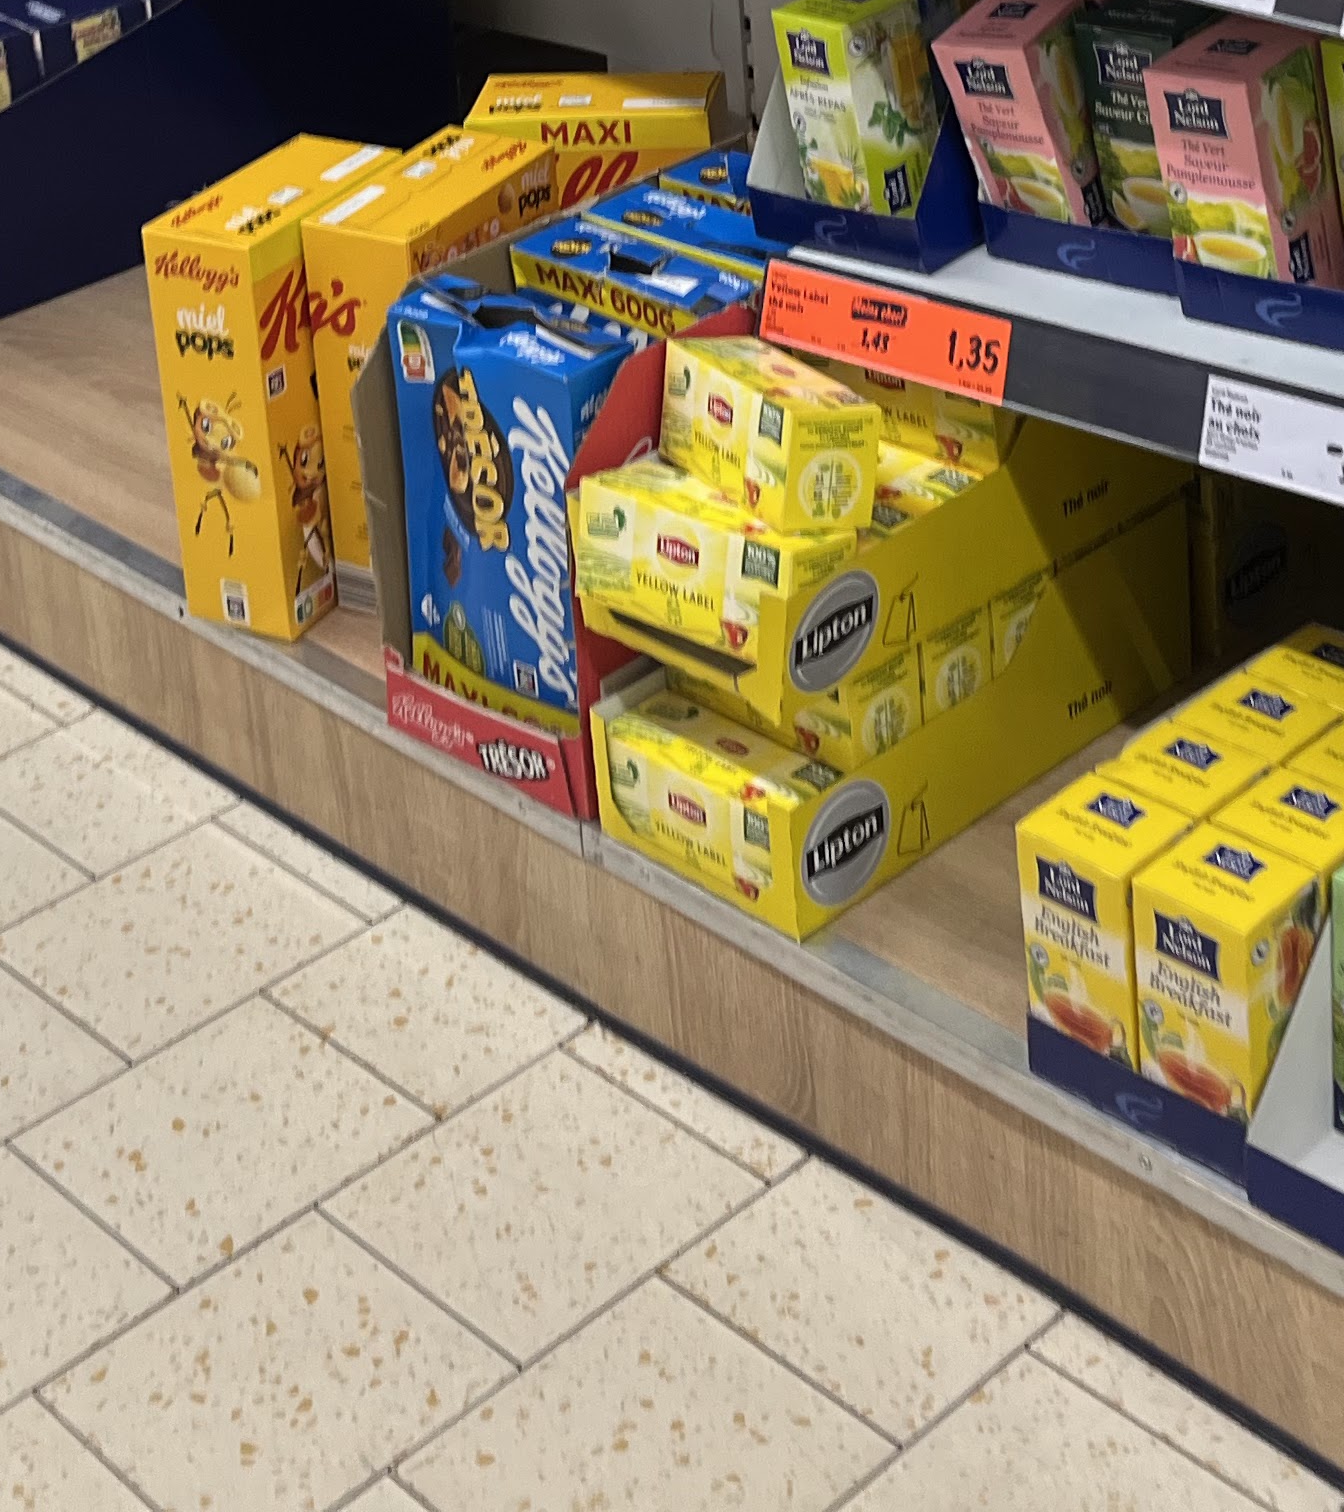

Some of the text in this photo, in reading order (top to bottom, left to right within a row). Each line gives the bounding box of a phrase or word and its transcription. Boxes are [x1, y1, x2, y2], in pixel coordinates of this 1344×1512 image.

[540, 119, 633, 147] MAXI
[1166, 163, 1255, 191] Pamplemousse
[154, 249, 240, 290] Kellogg's
[177, 304, 225, 333] miel
[535, 260, 677, 335] MAXI 600G
[175, 327, 235, 362] pops
[947, 330, 999, 376] 1,35
[635, 571, 715, 612] YELLOW LABEL
[794, 594, 871, 664] Lipton
[477, 738, 550, 782] TRÉSOR
[806, 814, 881, 875] Lipton
[1149, 973, 1233, 1029] Breakfast
